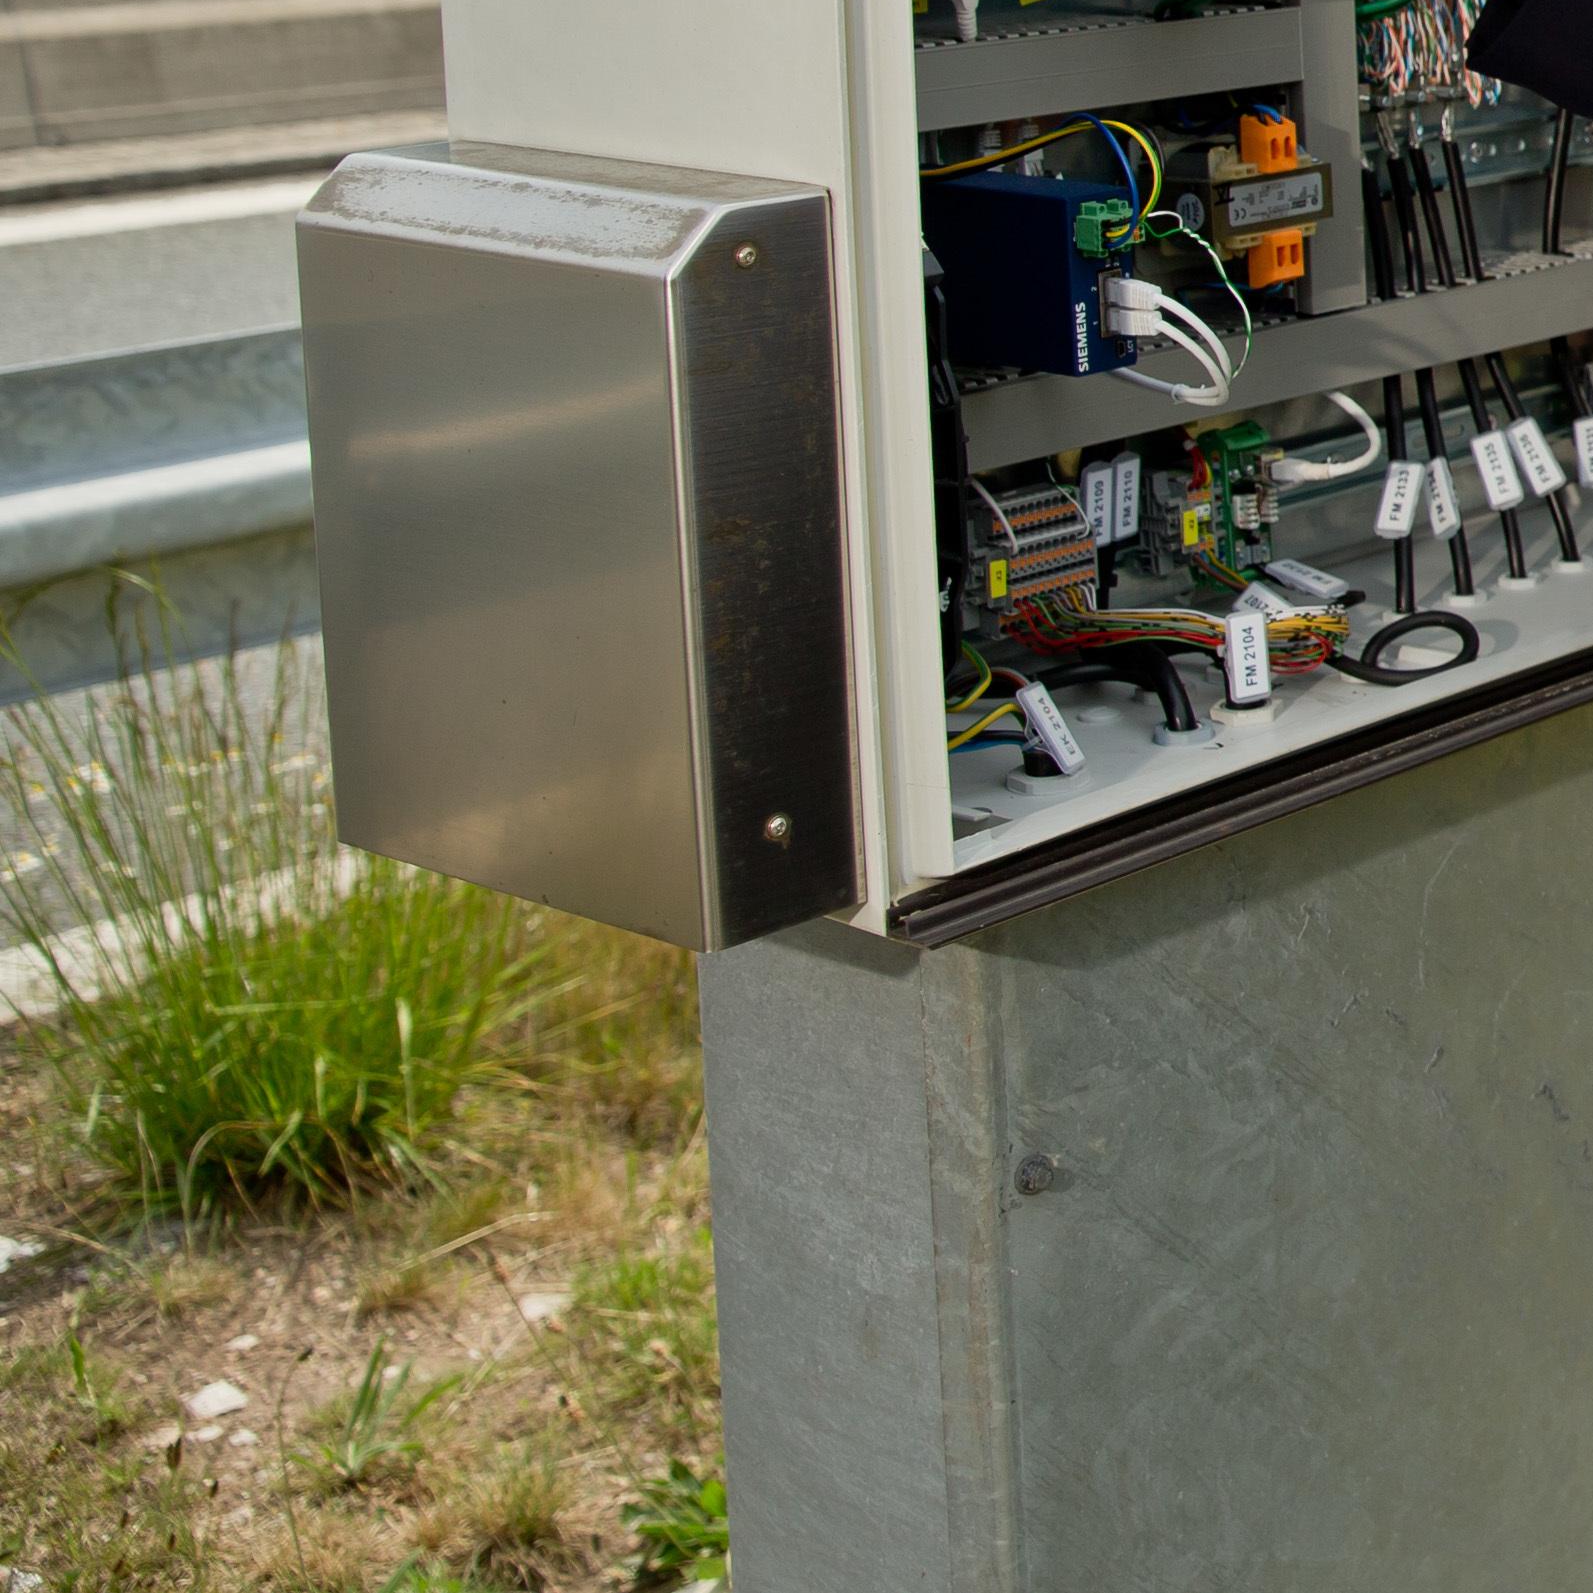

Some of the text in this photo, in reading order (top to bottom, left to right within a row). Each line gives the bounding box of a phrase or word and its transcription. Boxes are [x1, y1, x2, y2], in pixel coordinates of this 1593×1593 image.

[1075, 302, 1089, 373] SIEMENS
[1126, 339, 1134, 353] LCT
[1495, 475, 1511, 495] FM
[1535, 464, 1552, 484] FM
[1093, 479, 1104, 537] FM 2109
[1122, 469, 1133, 528] FM 2110
[1388, 503, 1403, 522] FM
[1435, 503, 1447, 524] FM
[1240, 625, 1259, 687] FM 2104
[1037, 696, 1076, 755] EK 2104
